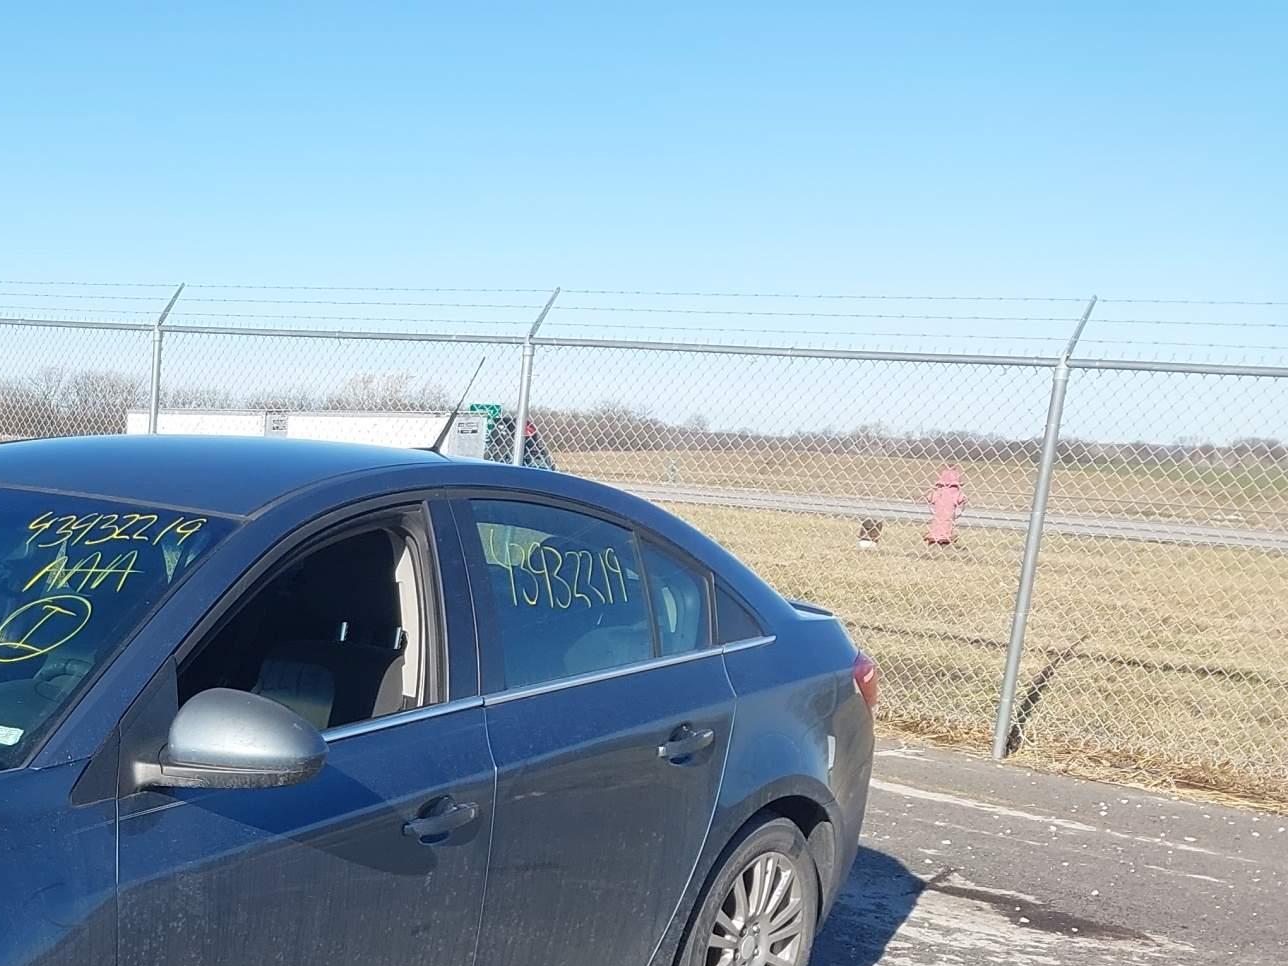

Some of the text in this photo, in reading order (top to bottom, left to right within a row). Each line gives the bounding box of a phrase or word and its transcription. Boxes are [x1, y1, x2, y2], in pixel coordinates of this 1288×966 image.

[27, 511, 207, 548] 43932219
[23, 551, 145, 593] AAA
[490, 528, 628, 608] 43932219
